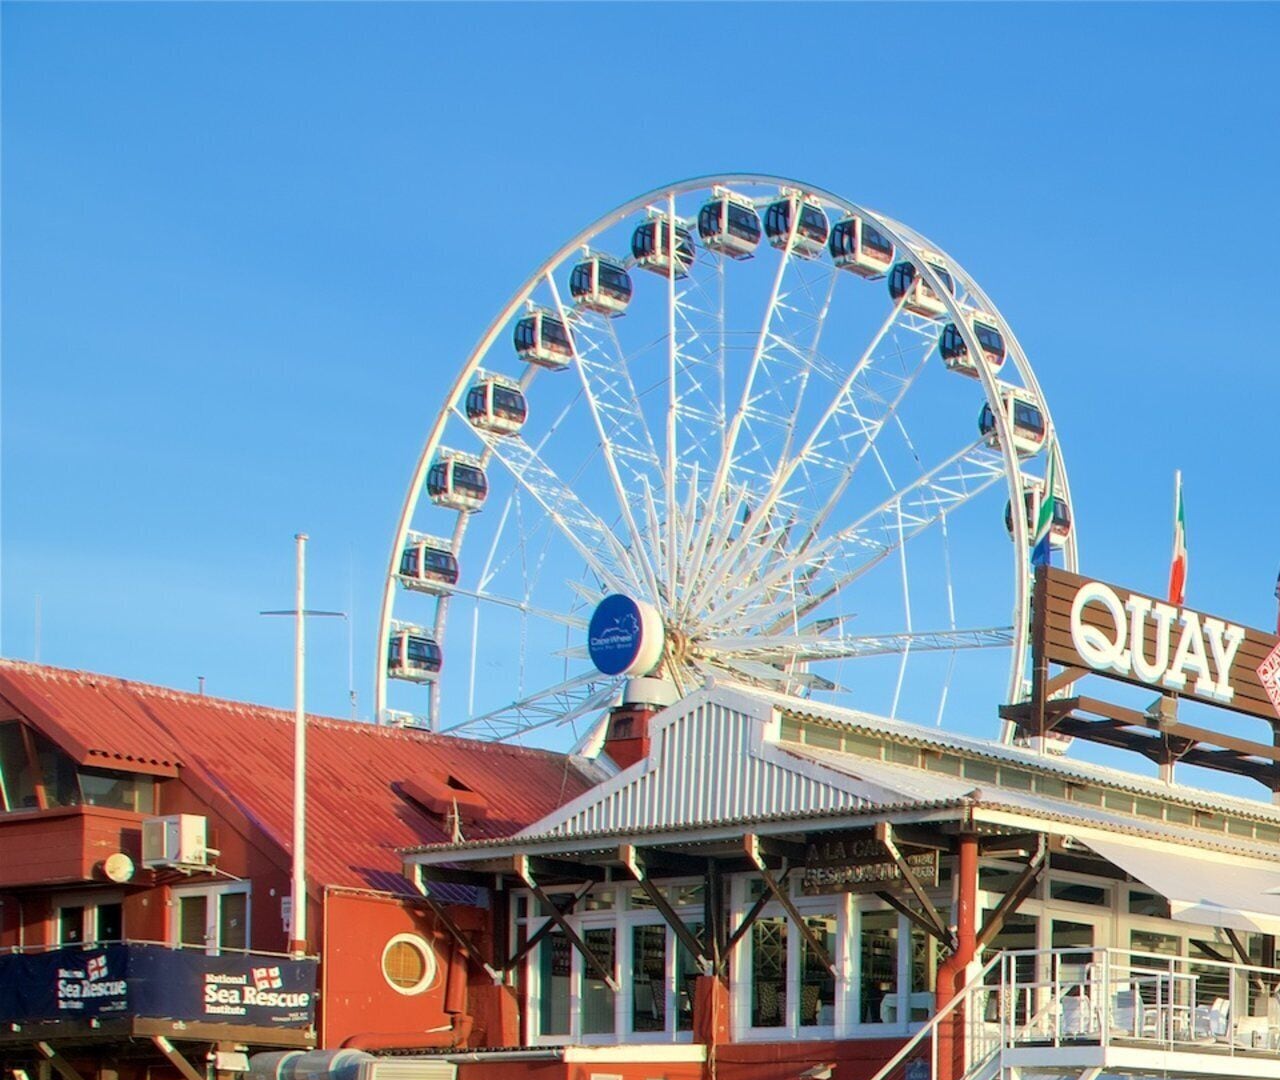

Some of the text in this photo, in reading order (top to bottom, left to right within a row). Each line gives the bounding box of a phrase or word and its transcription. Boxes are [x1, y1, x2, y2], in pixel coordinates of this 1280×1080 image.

[1070, 581, 1246, 703] QUAY
[57, 979, 127, 998] Sea Rescue
[205, 974, 247, 984] National
[204, 984, 310, 1007] Sea Rescue
[205, 1004, 246, 1015] Institute
